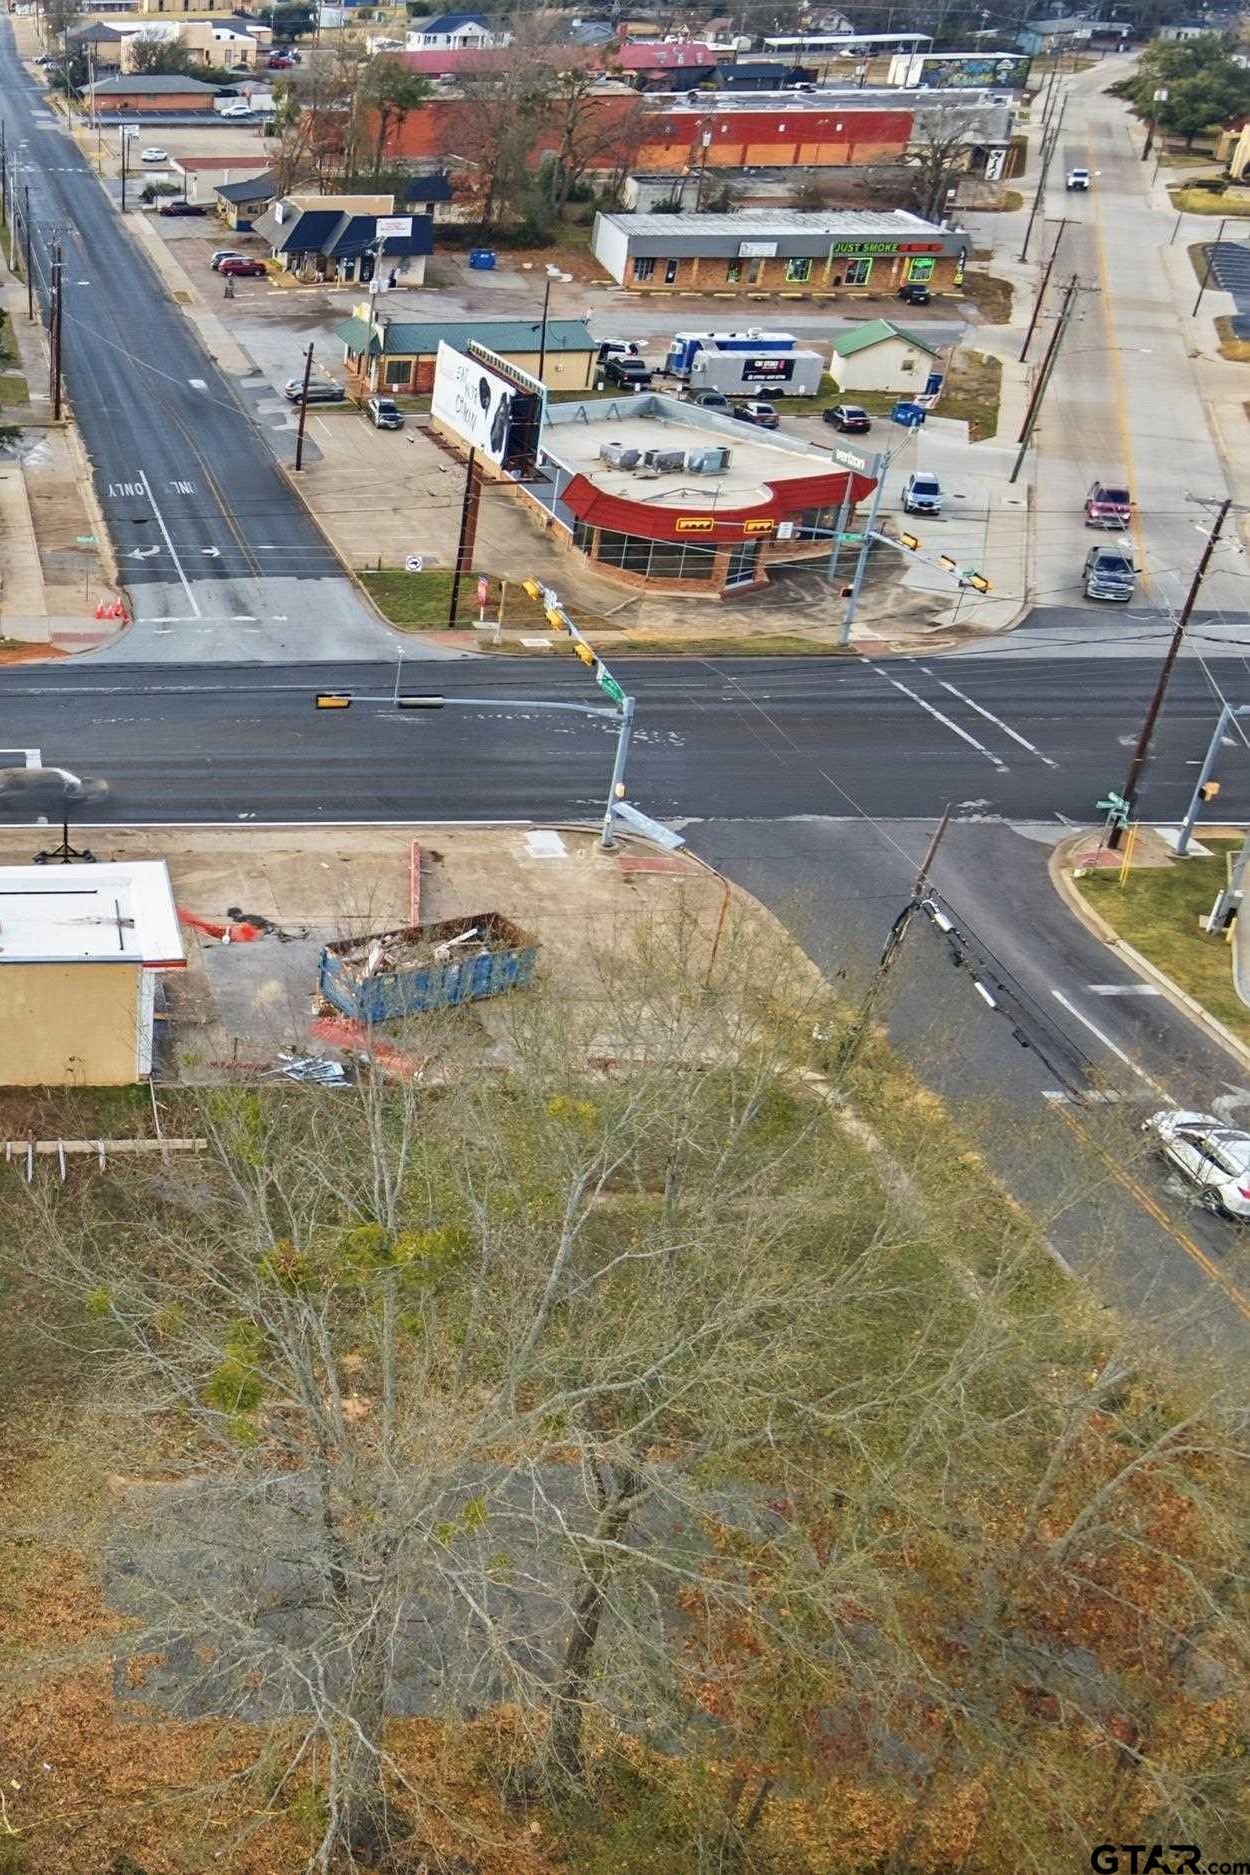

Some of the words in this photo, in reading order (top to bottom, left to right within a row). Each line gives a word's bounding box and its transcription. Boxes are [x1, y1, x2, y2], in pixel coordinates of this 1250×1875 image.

[835, 243, 861, 252] JUST
[863, 243, 899, 252] SMOKE
[836, 449, 865, 470] verizon
[109, 482, 145, 497] ONLY
